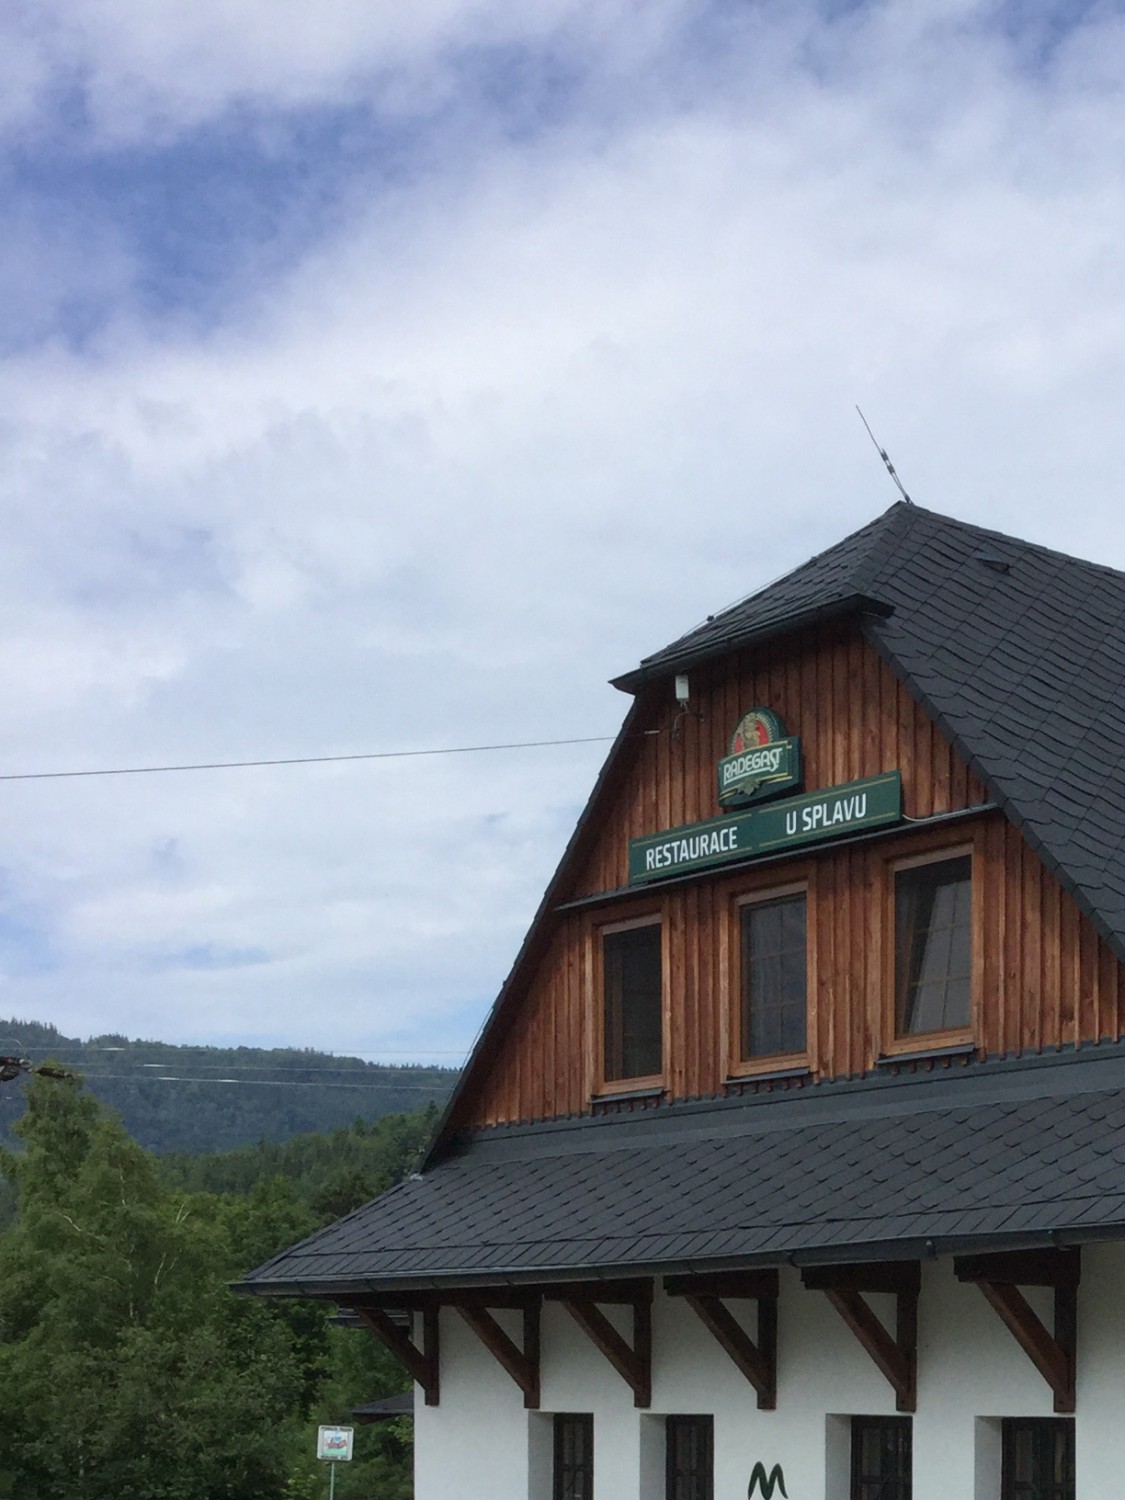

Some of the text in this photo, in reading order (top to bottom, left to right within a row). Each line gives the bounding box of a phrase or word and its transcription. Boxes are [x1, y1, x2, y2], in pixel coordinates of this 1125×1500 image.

[723, 747, 783, 784] RADEGAST
[646, 793, 867, 870] RESTAURACE U SPLAVU
